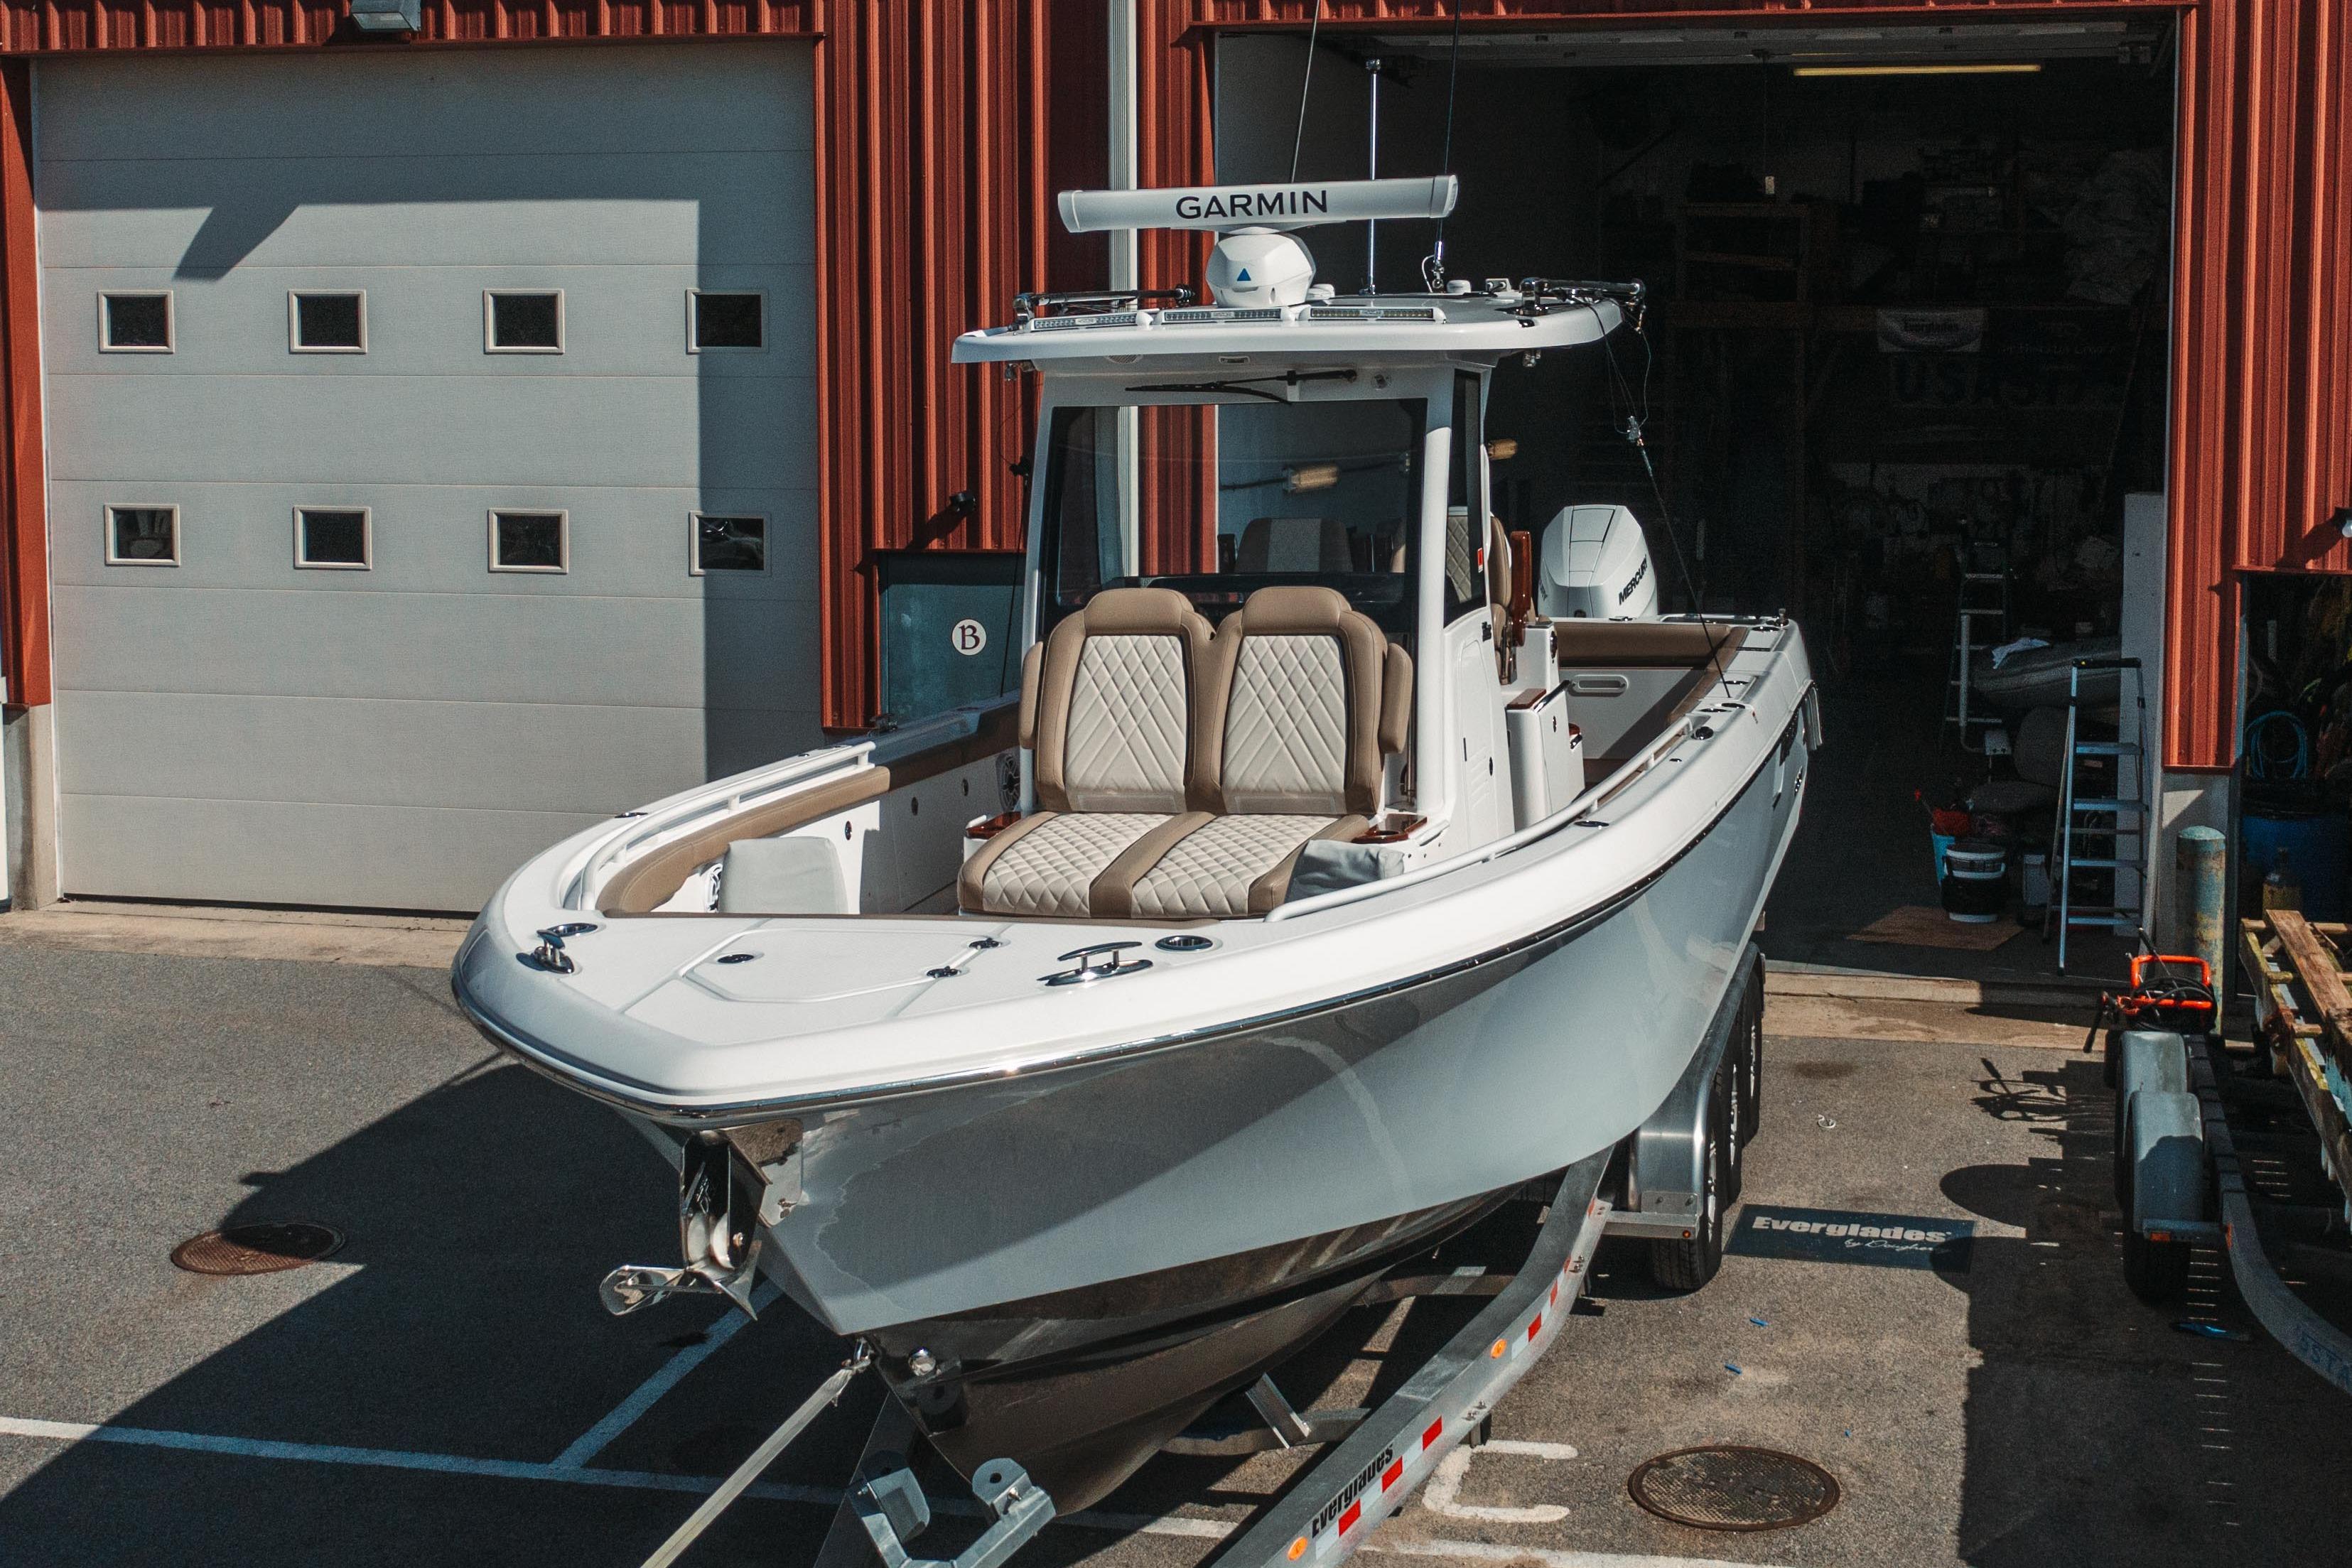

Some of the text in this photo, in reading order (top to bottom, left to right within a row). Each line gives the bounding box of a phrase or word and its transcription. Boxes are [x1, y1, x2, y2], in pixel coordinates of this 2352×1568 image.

[1176, 190, 1327, 219] GARMIN
[1619, 553, 1648, 605] MERCURY
[959, 625, 980, 649] B
[1752, 1216, 1946, 1243] Everglades
